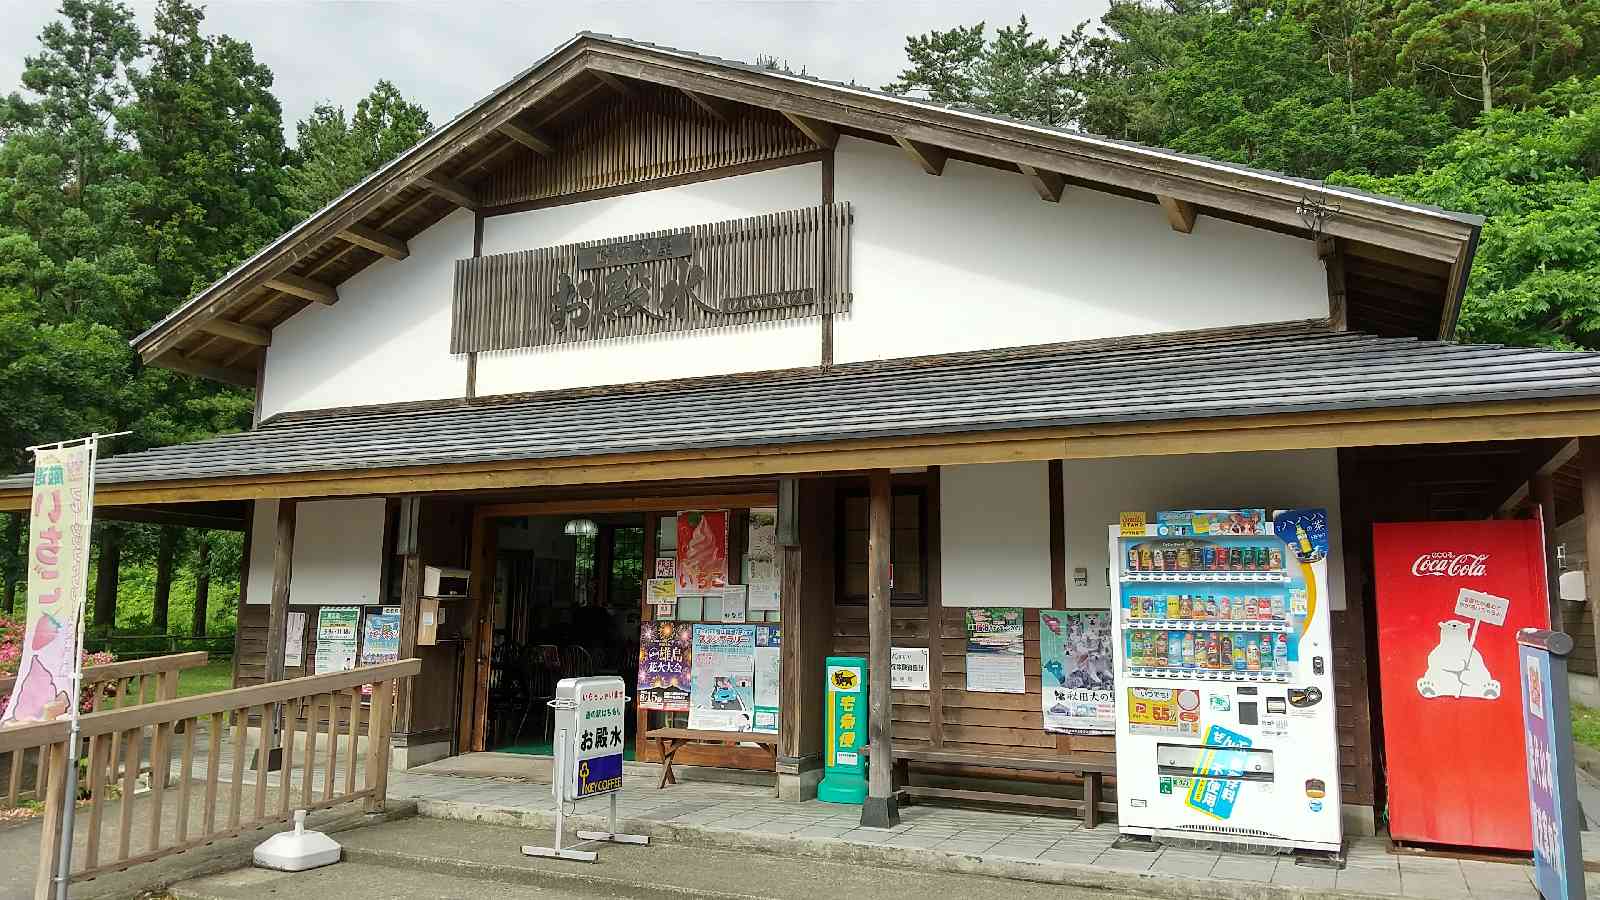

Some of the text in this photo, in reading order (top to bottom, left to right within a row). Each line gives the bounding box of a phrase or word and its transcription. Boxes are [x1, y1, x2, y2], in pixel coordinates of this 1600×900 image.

[551, 259, 719, 331] お殿水
[1412, 553, 1490, 577] Coca-Cola
[648, 661, 682, 673] 花火大会
[839, 695, 856, 748] 宅急便
[581, 726, 622, 752] お殿水
[585, 776, 622, 794] KEY COFFEE
